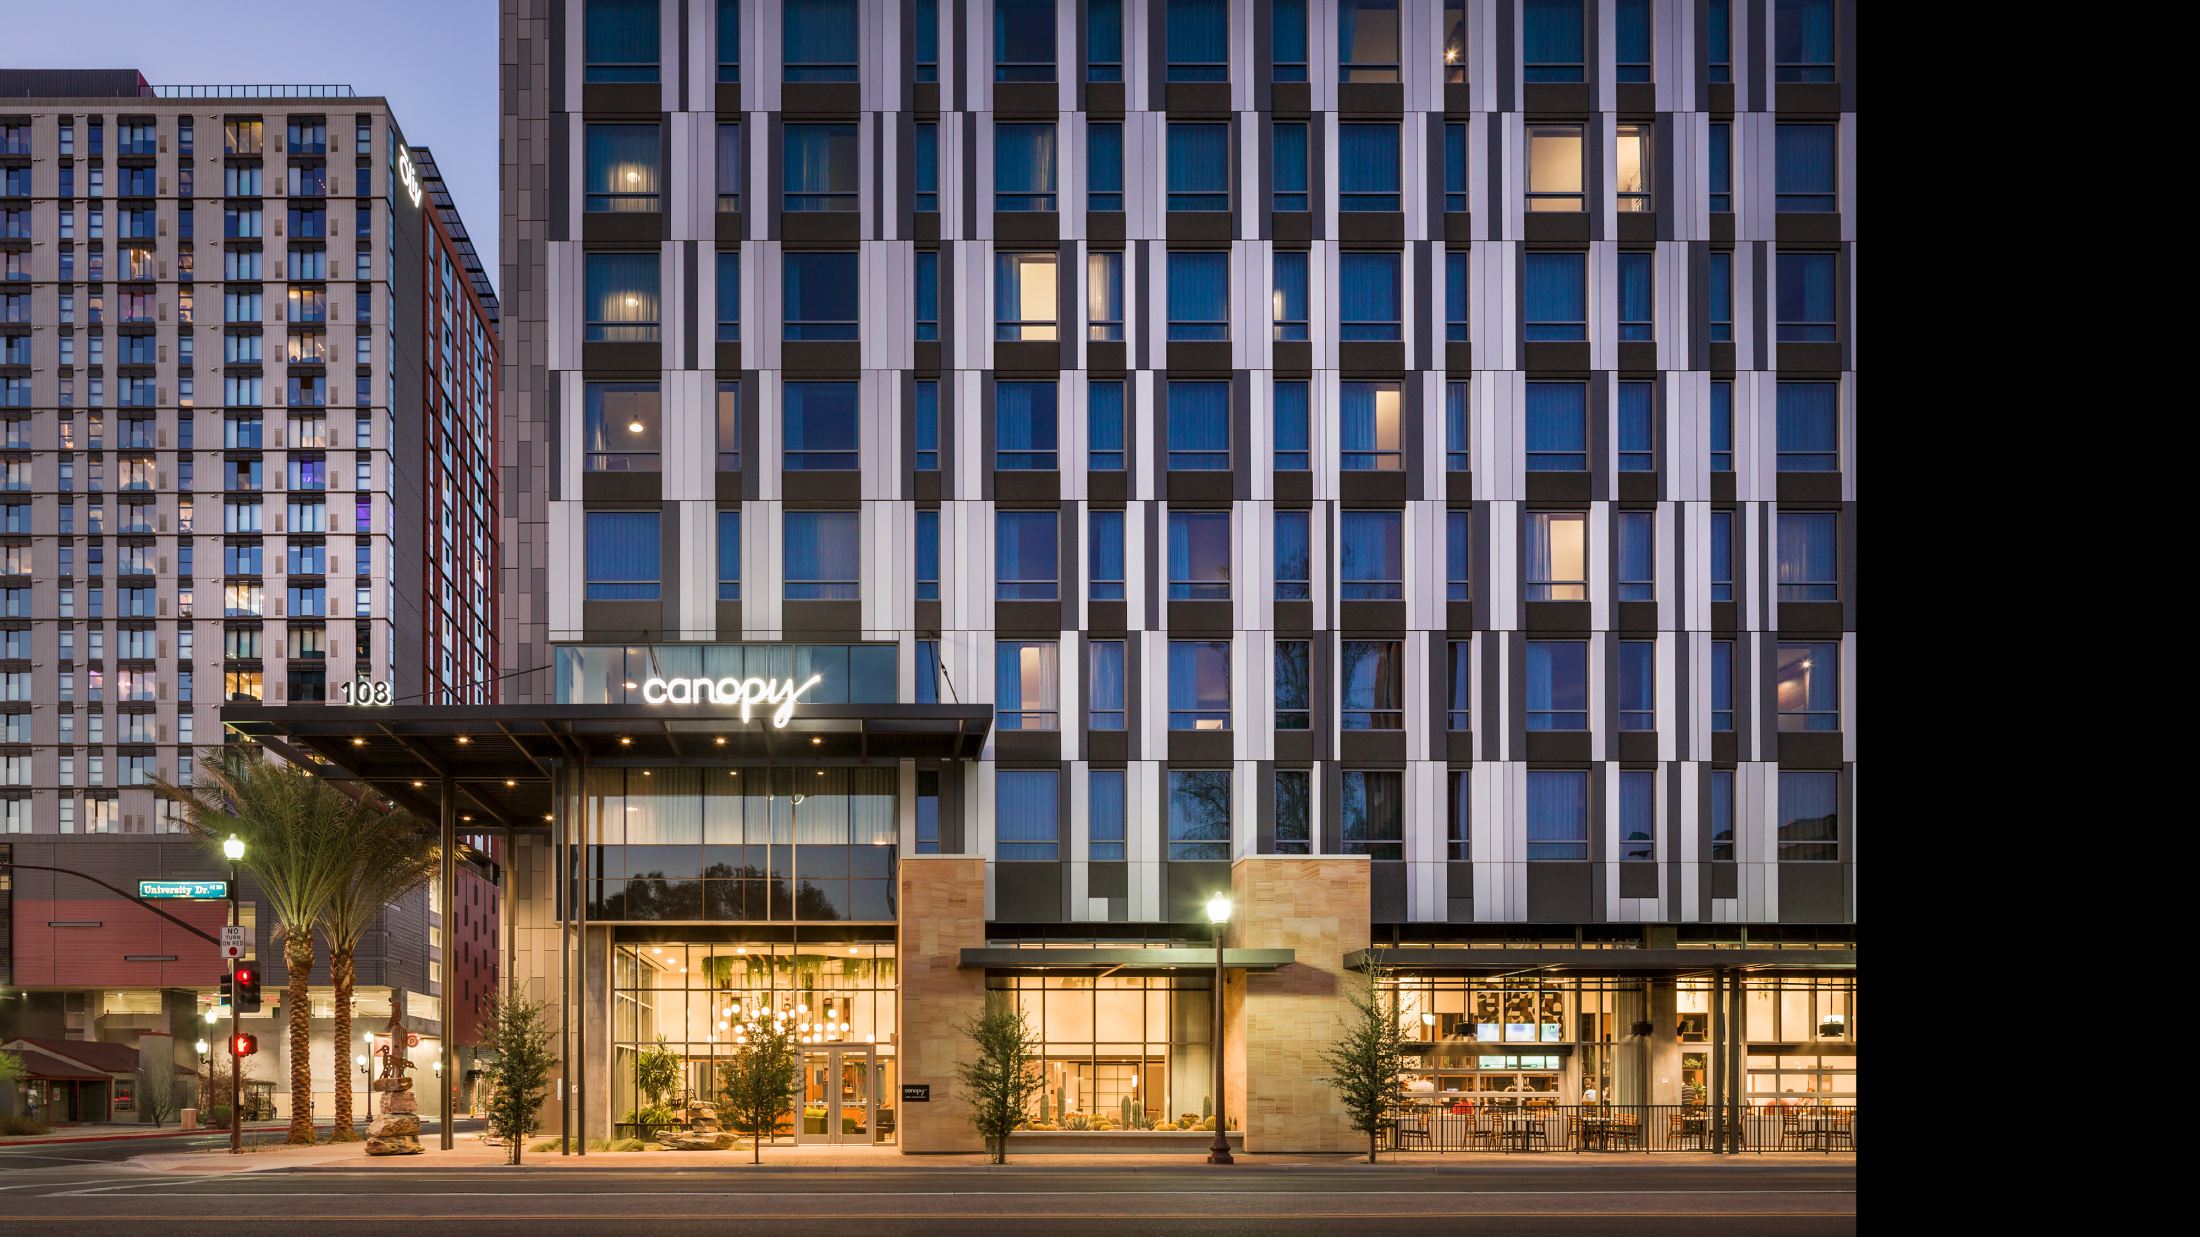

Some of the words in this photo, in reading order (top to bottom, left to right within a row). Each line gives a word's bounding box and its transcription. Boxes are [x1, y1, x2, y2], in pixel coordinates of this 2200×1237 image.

[341, 681, 391, 705] 108
[643, 675, 821, 728] canopy
[144, 885, 192, 896] University
[195, 885, 210, 894] Dr.
